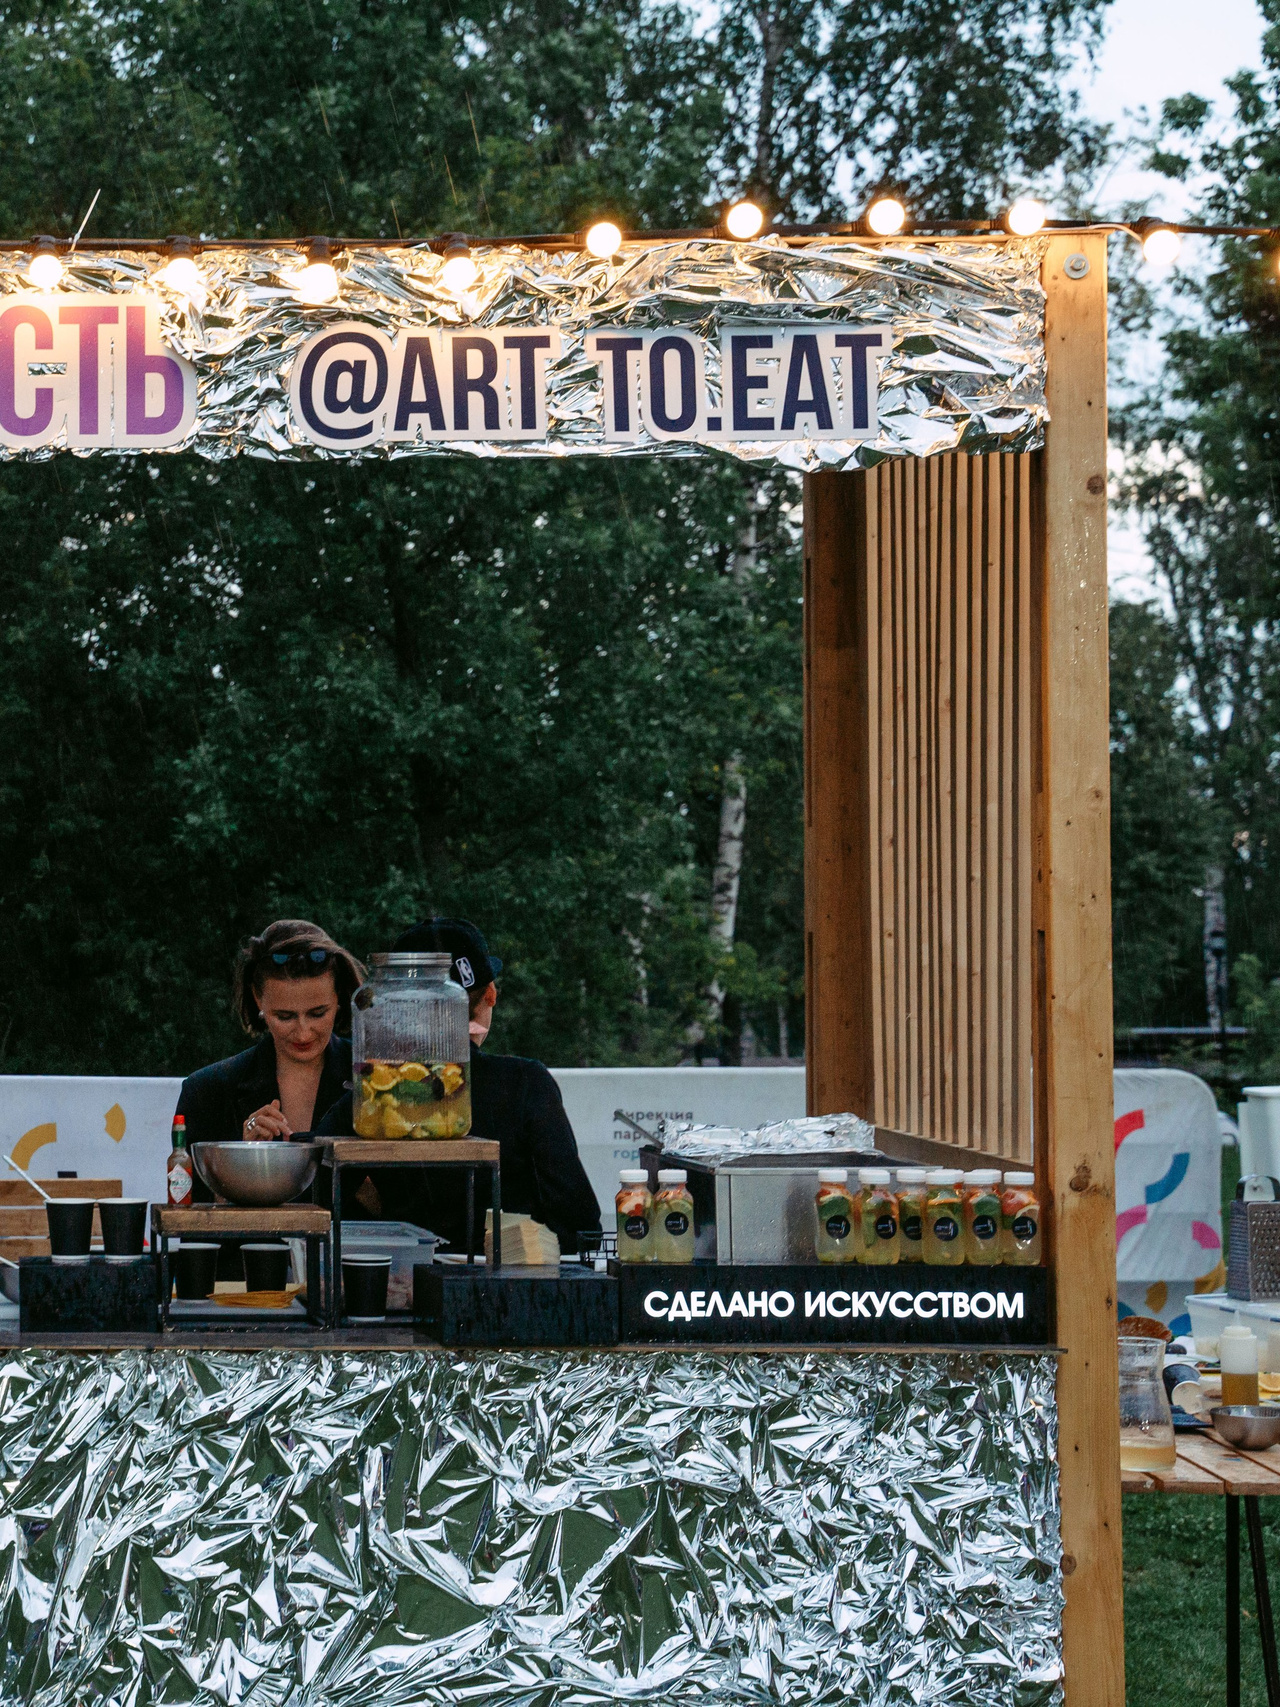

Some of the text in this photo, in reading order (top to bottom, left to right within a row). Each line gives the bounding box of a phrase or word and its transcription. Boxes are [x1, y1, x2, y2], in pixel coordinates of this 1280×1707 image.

[299, 332, 883, 438] @ART TO.EAT
[644, 1290, 1024, 1322] СДЕЛАНО ИСКУССТВОМ
